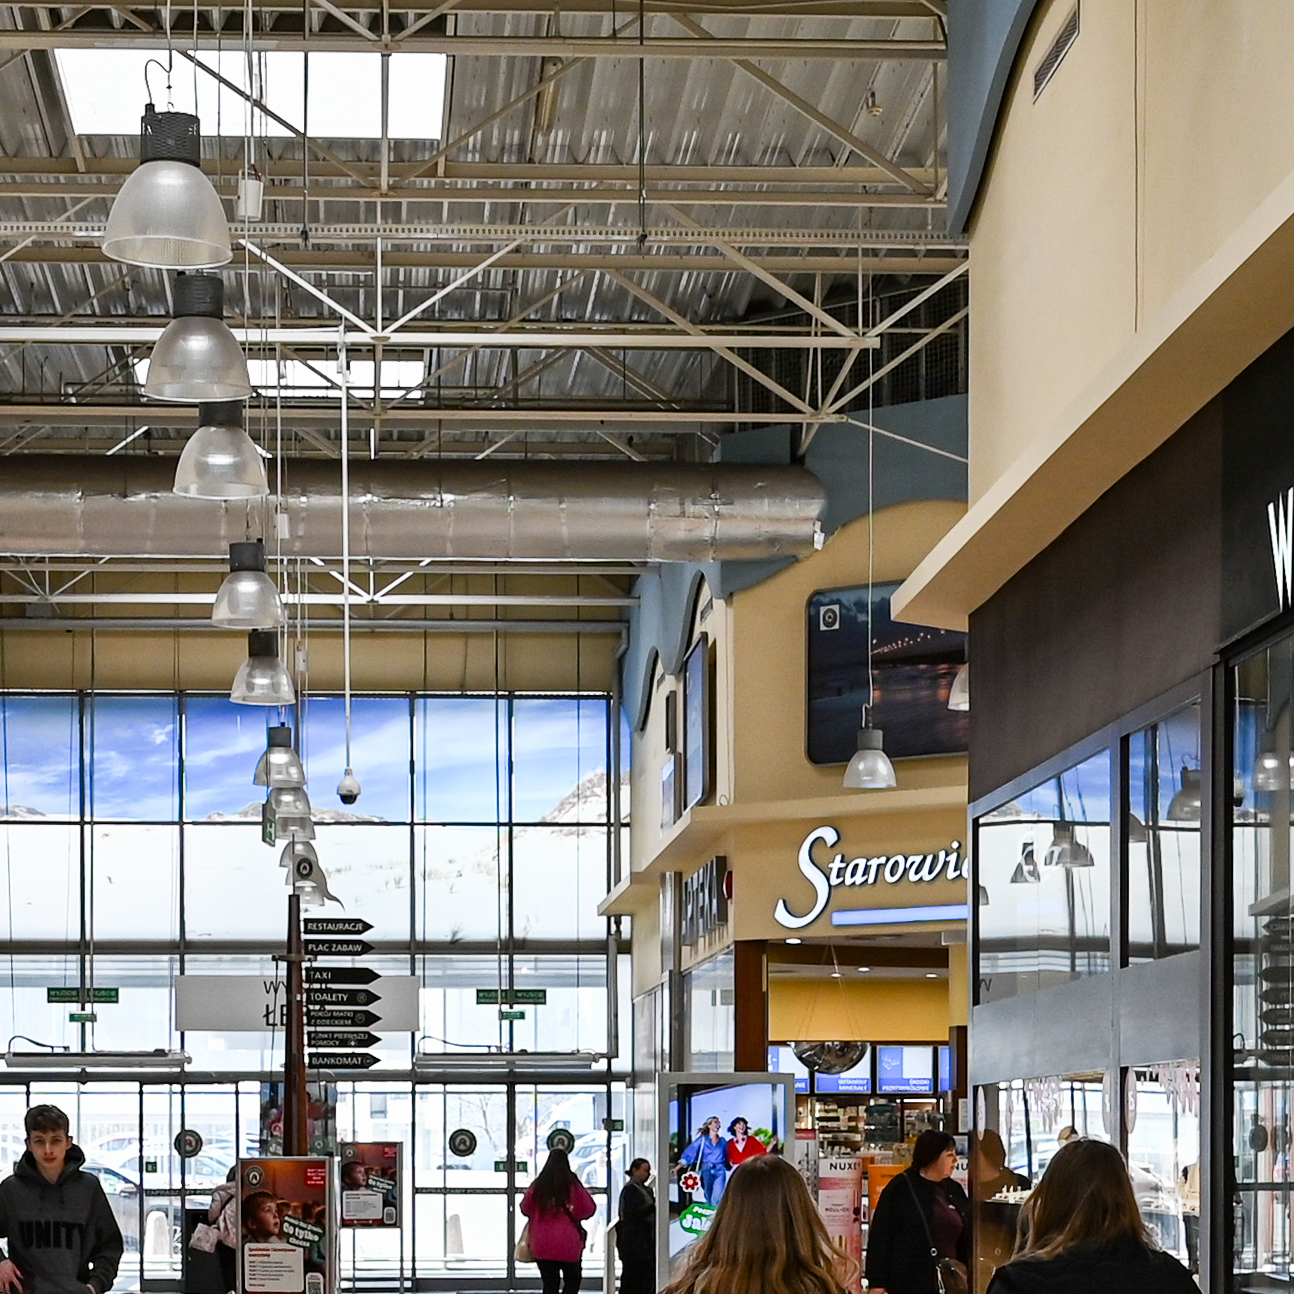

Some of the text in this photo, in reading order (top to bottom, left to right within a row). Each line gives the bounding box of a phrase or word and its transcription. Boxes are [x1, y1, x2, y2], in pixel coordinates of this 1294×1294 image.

[307, 922, 364, 931] RESTAURACJE
[308, 943, 363, 952] PLAC ZABAW
[309, 971, 332, 980] TAXI
[309, 993, 349, 1002] TOALETY
[311, 1056, 362, 1066] BANKOMAT
[18, 1219, 86, 1250] UNITY
